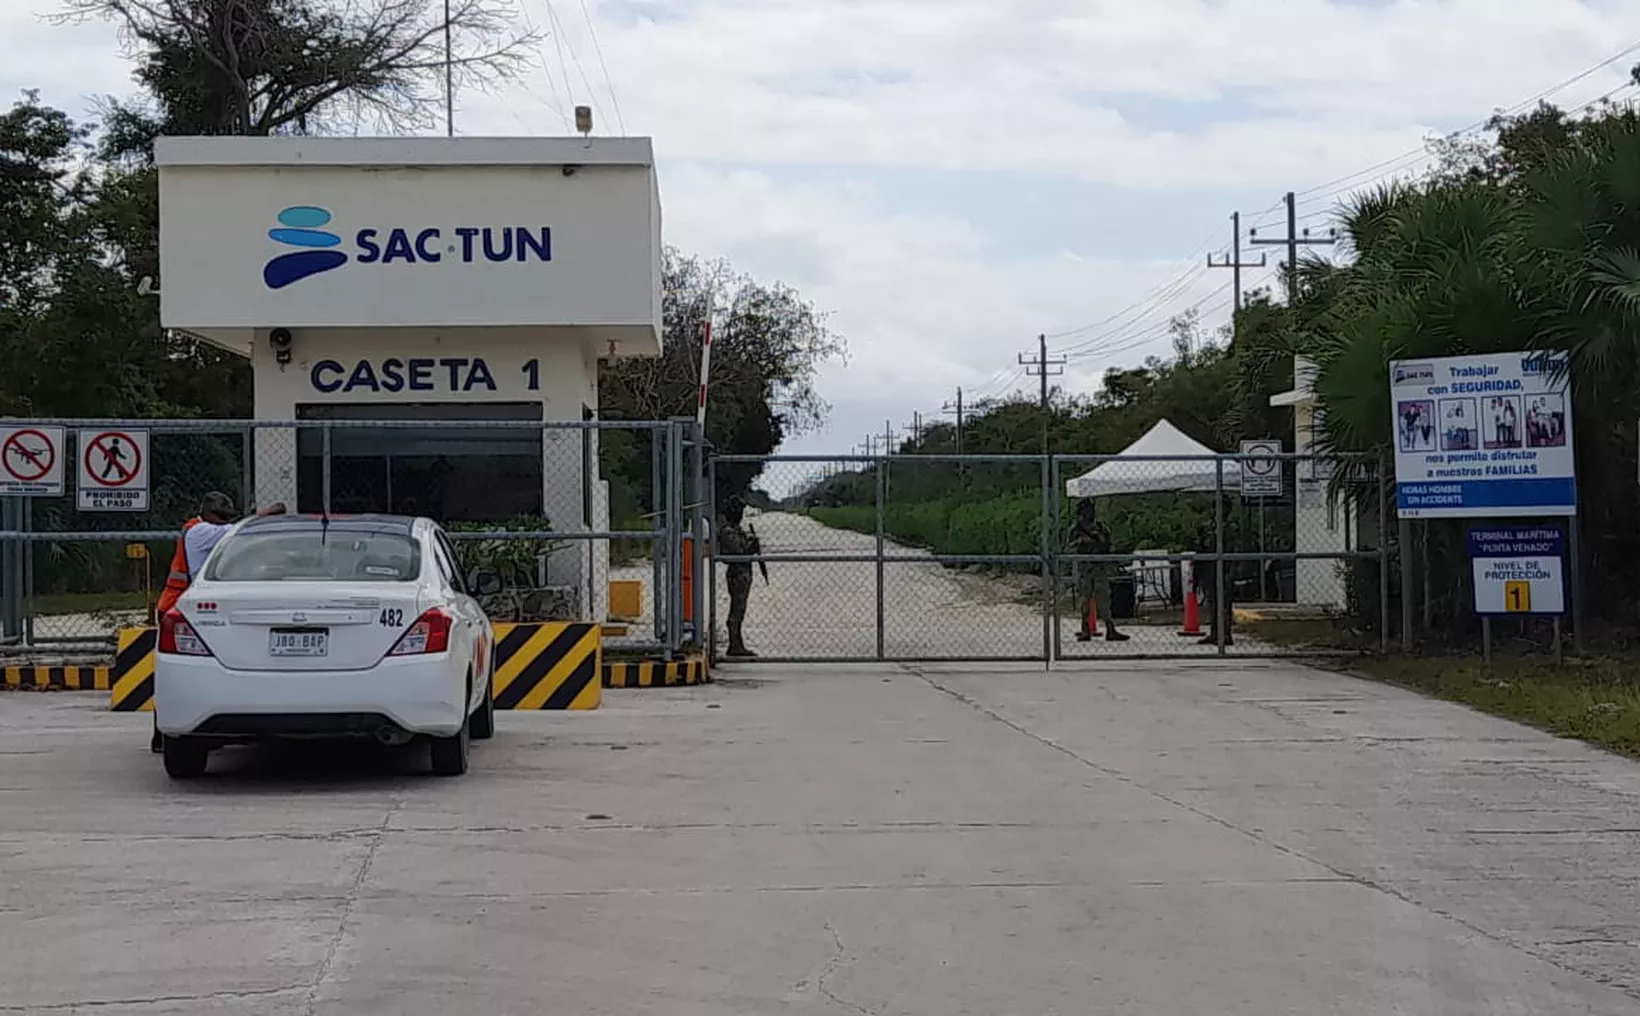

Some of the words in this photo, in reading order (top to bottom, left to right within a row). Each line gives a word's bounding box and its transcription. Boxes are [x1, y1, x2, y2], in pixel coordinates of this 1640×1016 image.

[310, 358, 497, 393] CASETA
[521, 359, 540, 390] 1
[1450, 365, 1499, 378] Trabajar
[1427, 386, 1448, 395] con
[1451, 379, 1524, 394] SEGURIDAD,
[1425, 453, 1444, 463] nos
[1447, 452, 1488, 465] permite
[1491, 450, 1537, 461] disfrutar
[1436, 467, 1482, 477] nuestras
[1485, 464, 1538, 476] FAMILIAS
[1402, 486, 1428, 494] HORAS
[1430, 485, 1462, 494] HOMBRE
[107, 500, 132, 508] PASO
[1408, 496, 1420, 504] SIN
[1421, 495, 1462, 504] ACCIDENTE
[1471, 531, 1514, 541] TERMINAL
[1493, 562, 1523, 570] NIVEL
[1525, 561, 1540, 570] DE
[1485, 570, 1551, 579] PROTECCIÓN
[1510, 587, 1520, 610] 1
[380, 608, 403, 627] 482
